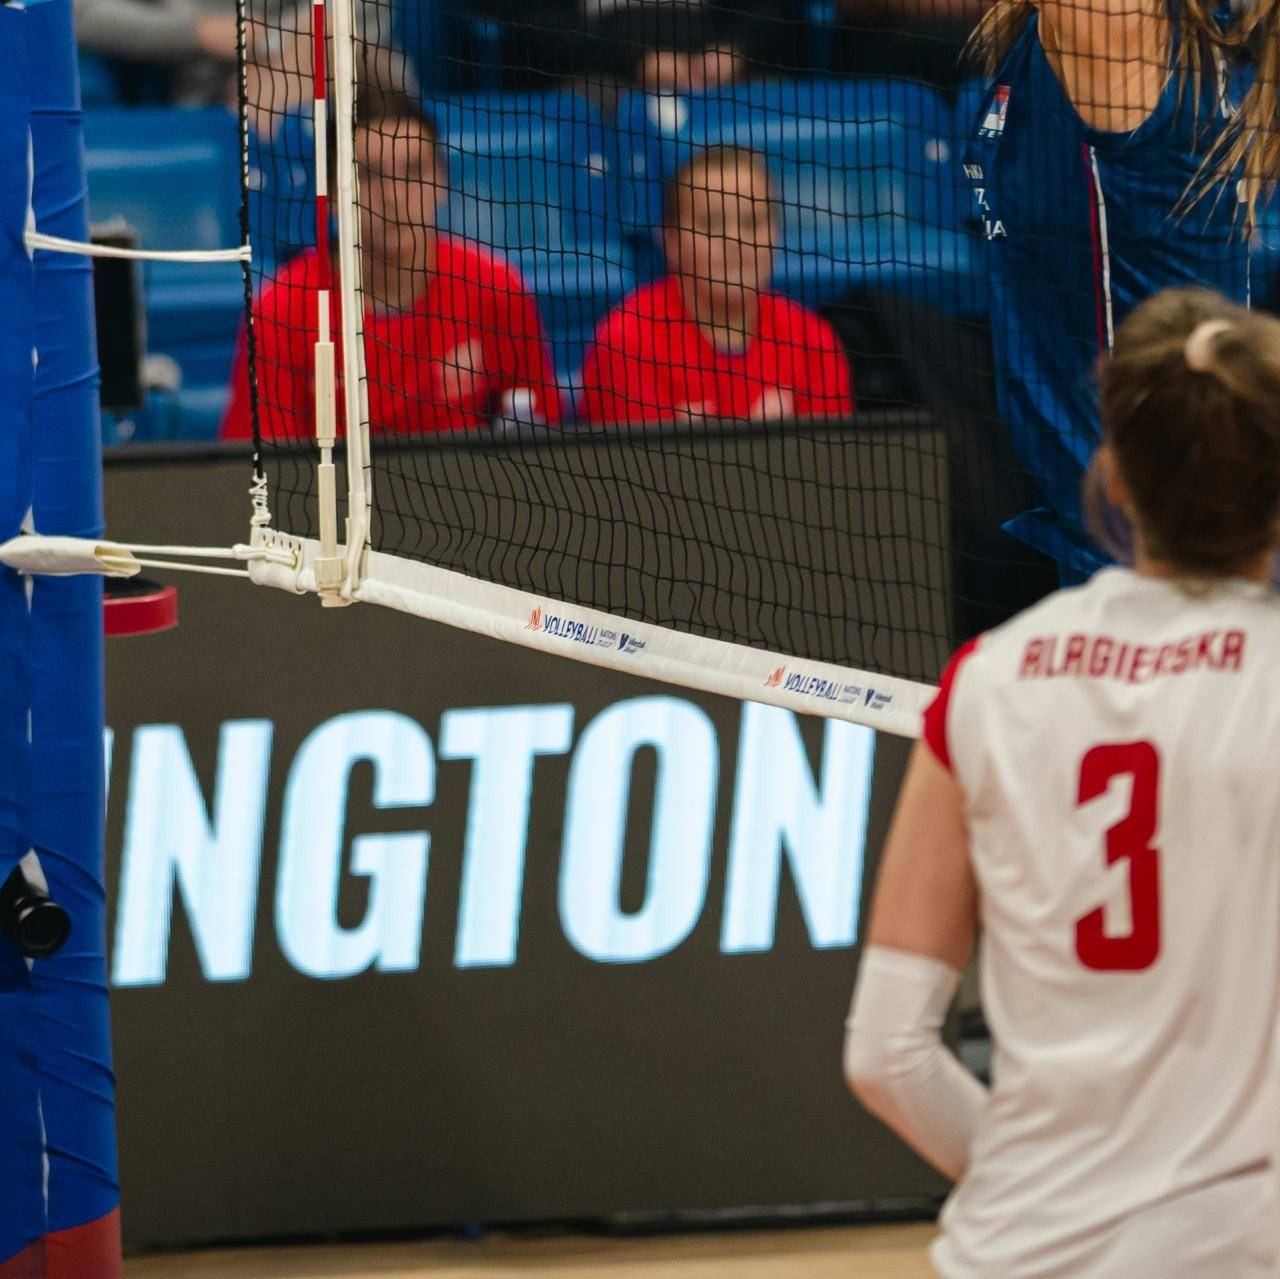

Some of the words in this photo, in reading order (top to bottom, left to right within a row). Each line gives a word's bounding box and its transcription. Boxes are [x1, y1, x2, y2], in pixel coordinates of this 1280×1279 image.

[543, 614, 599, 645] VOLLEYBALL
[103, 695, 876, 988] NGTON
[1073, 739, 1161, 972] 3
